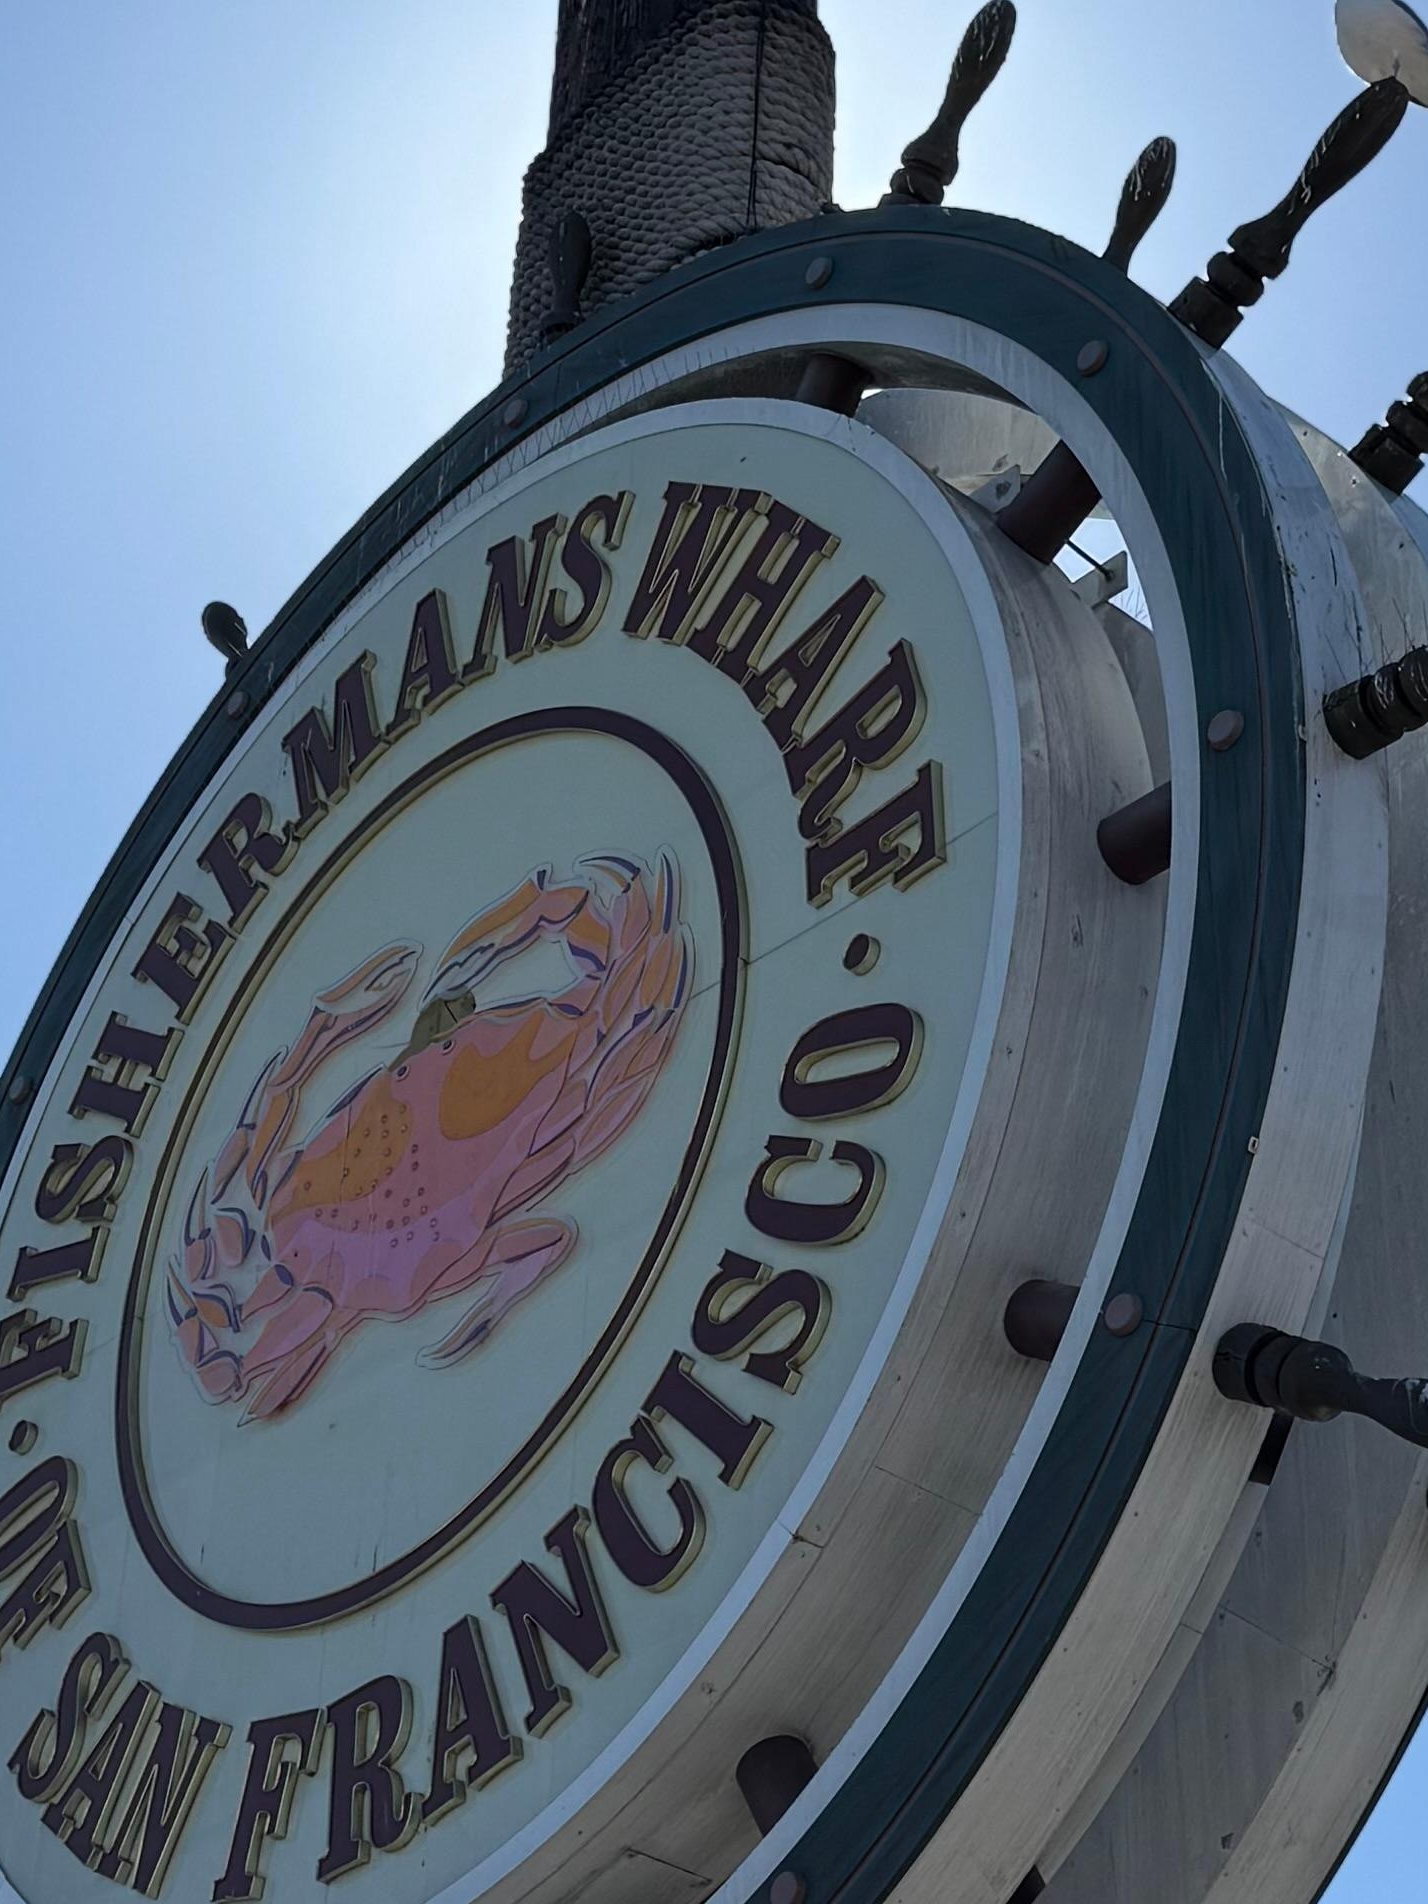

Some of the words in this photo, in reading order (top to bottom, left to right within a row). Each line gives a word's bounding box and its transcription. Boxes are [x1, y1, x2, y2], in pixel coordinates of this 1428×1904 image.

[621, 480, 947, 909] WHARF
[7, 1632, 232, 1900] SAN
[211, 998, 924, 1904] FRANCISCO
